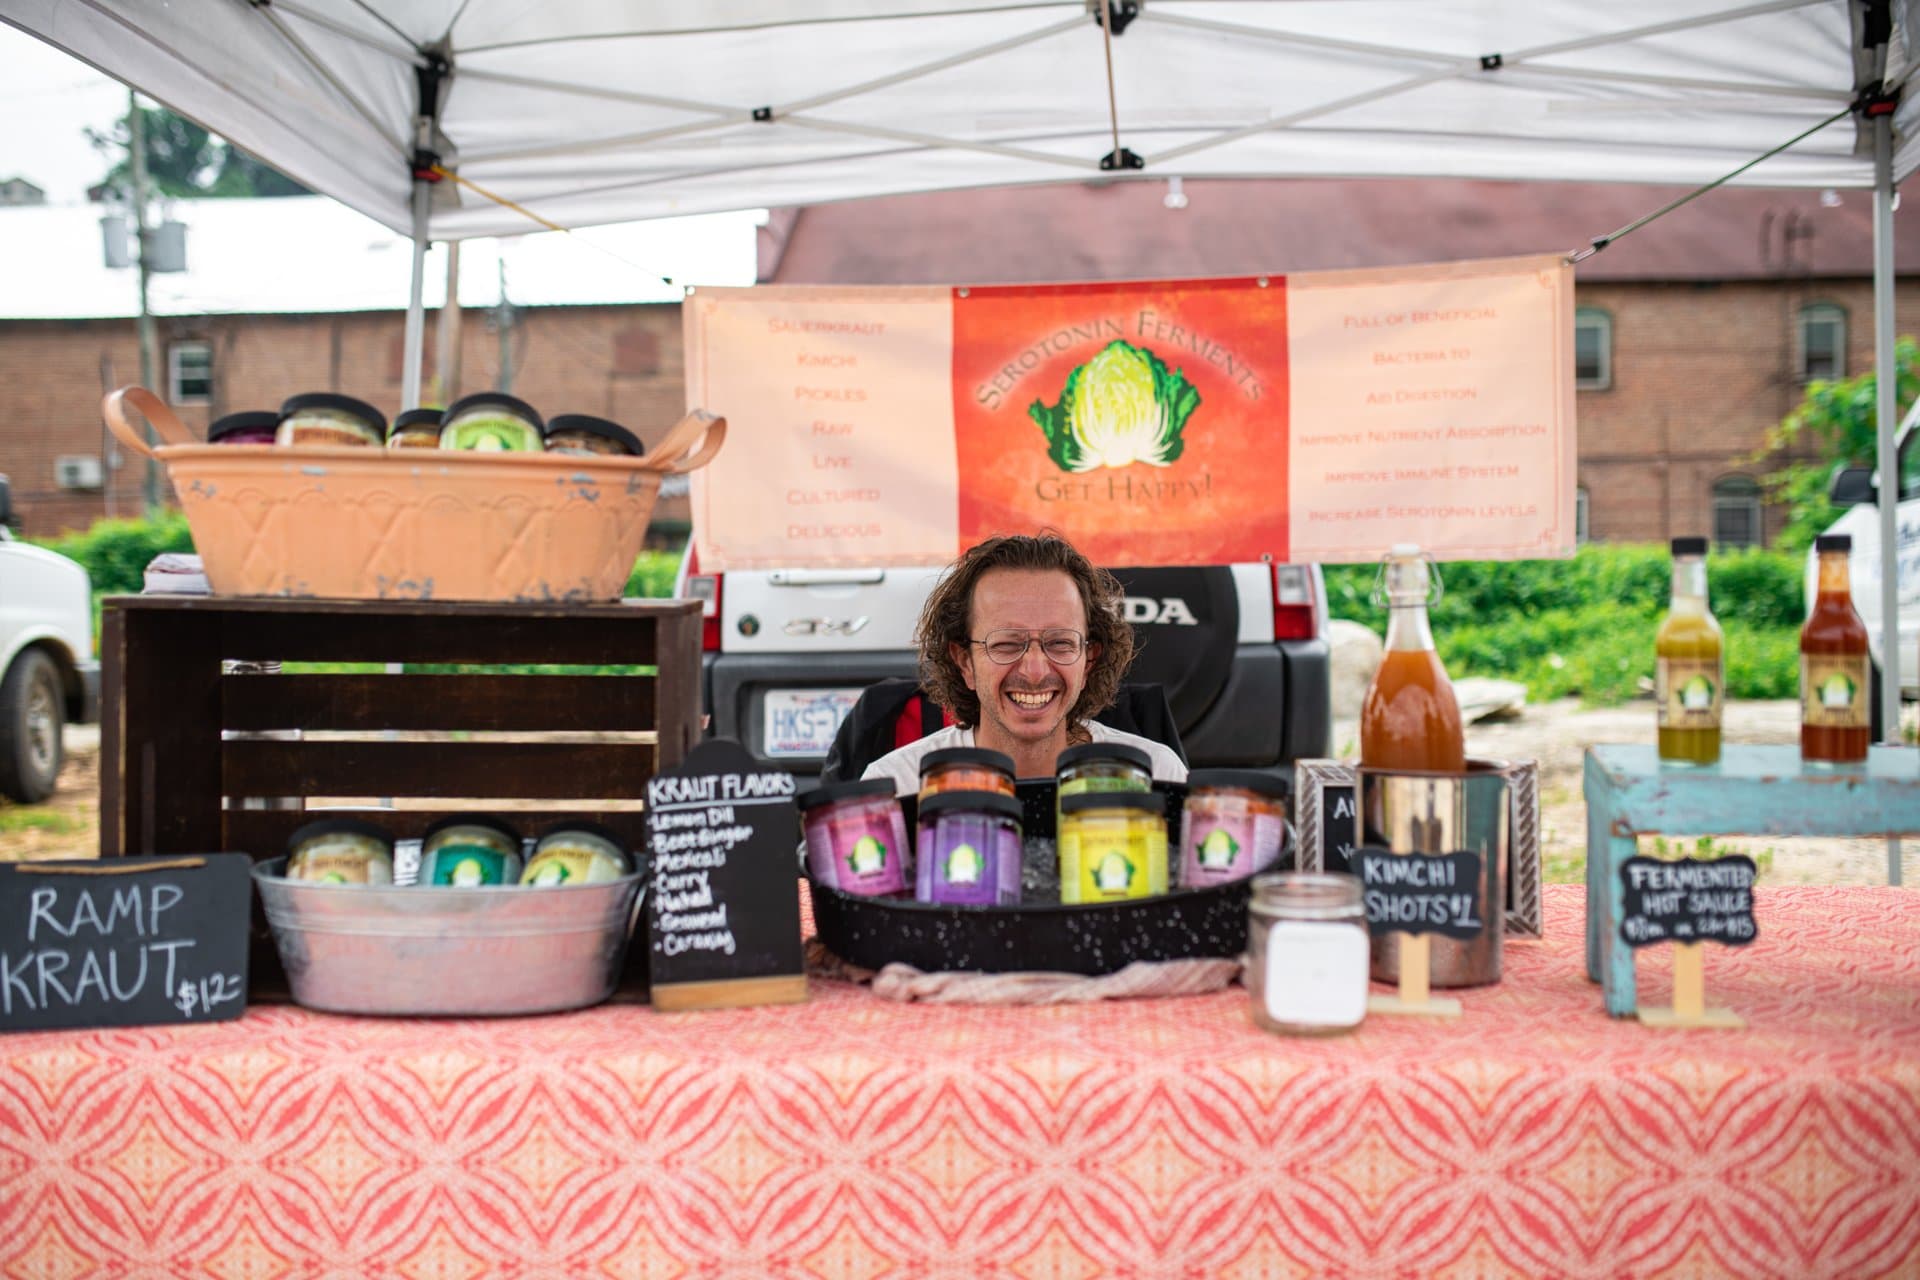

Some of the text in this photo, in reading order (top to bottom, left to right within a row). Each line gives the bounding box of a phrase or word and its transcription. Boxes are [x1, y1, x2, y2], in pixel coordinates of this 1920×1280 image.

[767, 318, 887, 336] SAUERKRAUT
[797, 352, 857, 368] KIMCHI
[975, 309, 1267, 411] SEROTONIN FERMENTS
[794, 386, 868, 402] PICKLES
[811, 420, 853, 436] RAW
[812, 454, 853, 470] LIVE
[786, 488, 881, 506] CULTURED
[1035, 473, 1214, 502] GET HAPPY!
[787, 522, 882, 540] DELICIOUS
[648, 774, 719, 807] KRAUT
[1363, 856, 1456, 887] KIMCHI
[28, 883, 184, 942] RAMP
[1365, 889, 1449, 924] SHOTS
[1641, 889, 1750, 916] HOT SAUCE
[1, 939, 196, 1015] KRAUT
